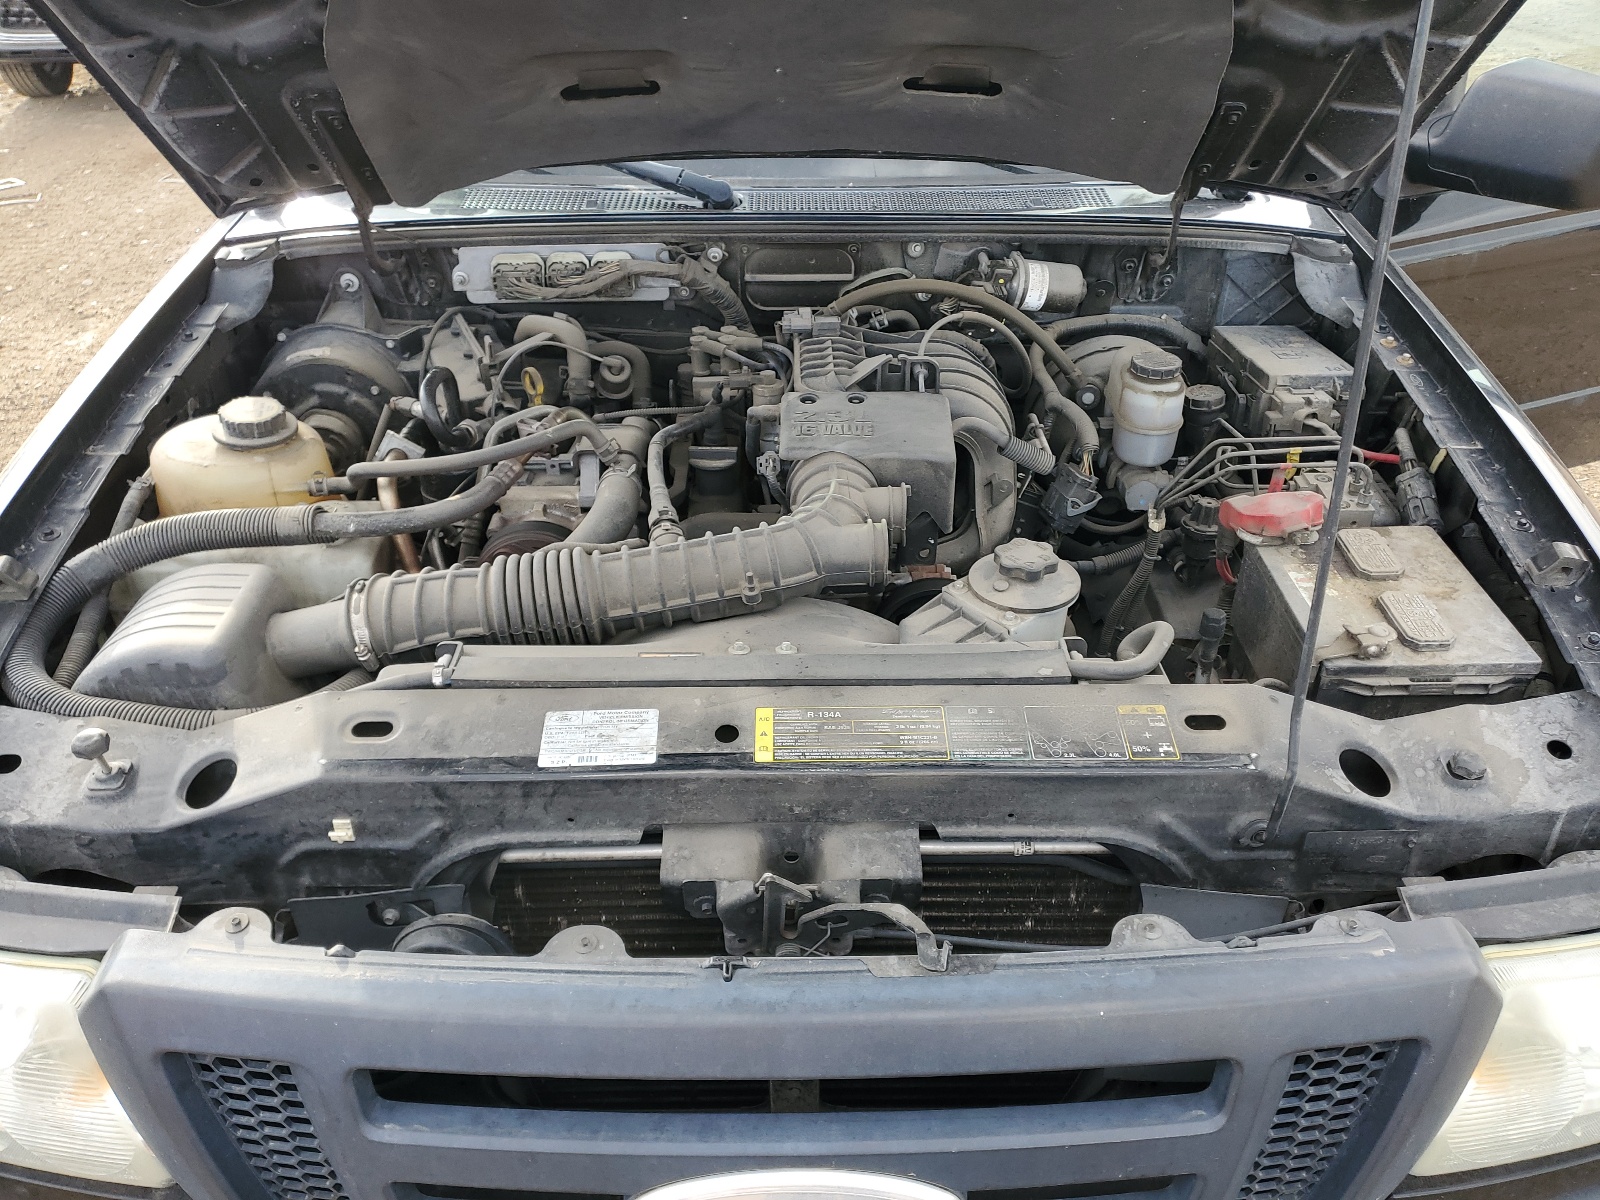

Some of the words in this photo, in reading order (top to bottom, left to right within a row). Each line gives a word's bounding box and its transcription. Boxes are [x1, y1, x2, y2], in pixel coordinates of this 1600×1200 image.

[794, 424, 818, 437] 16
[822, 423, 874, 437] VALVE
[1132, 745, 1152, 753] 50%
